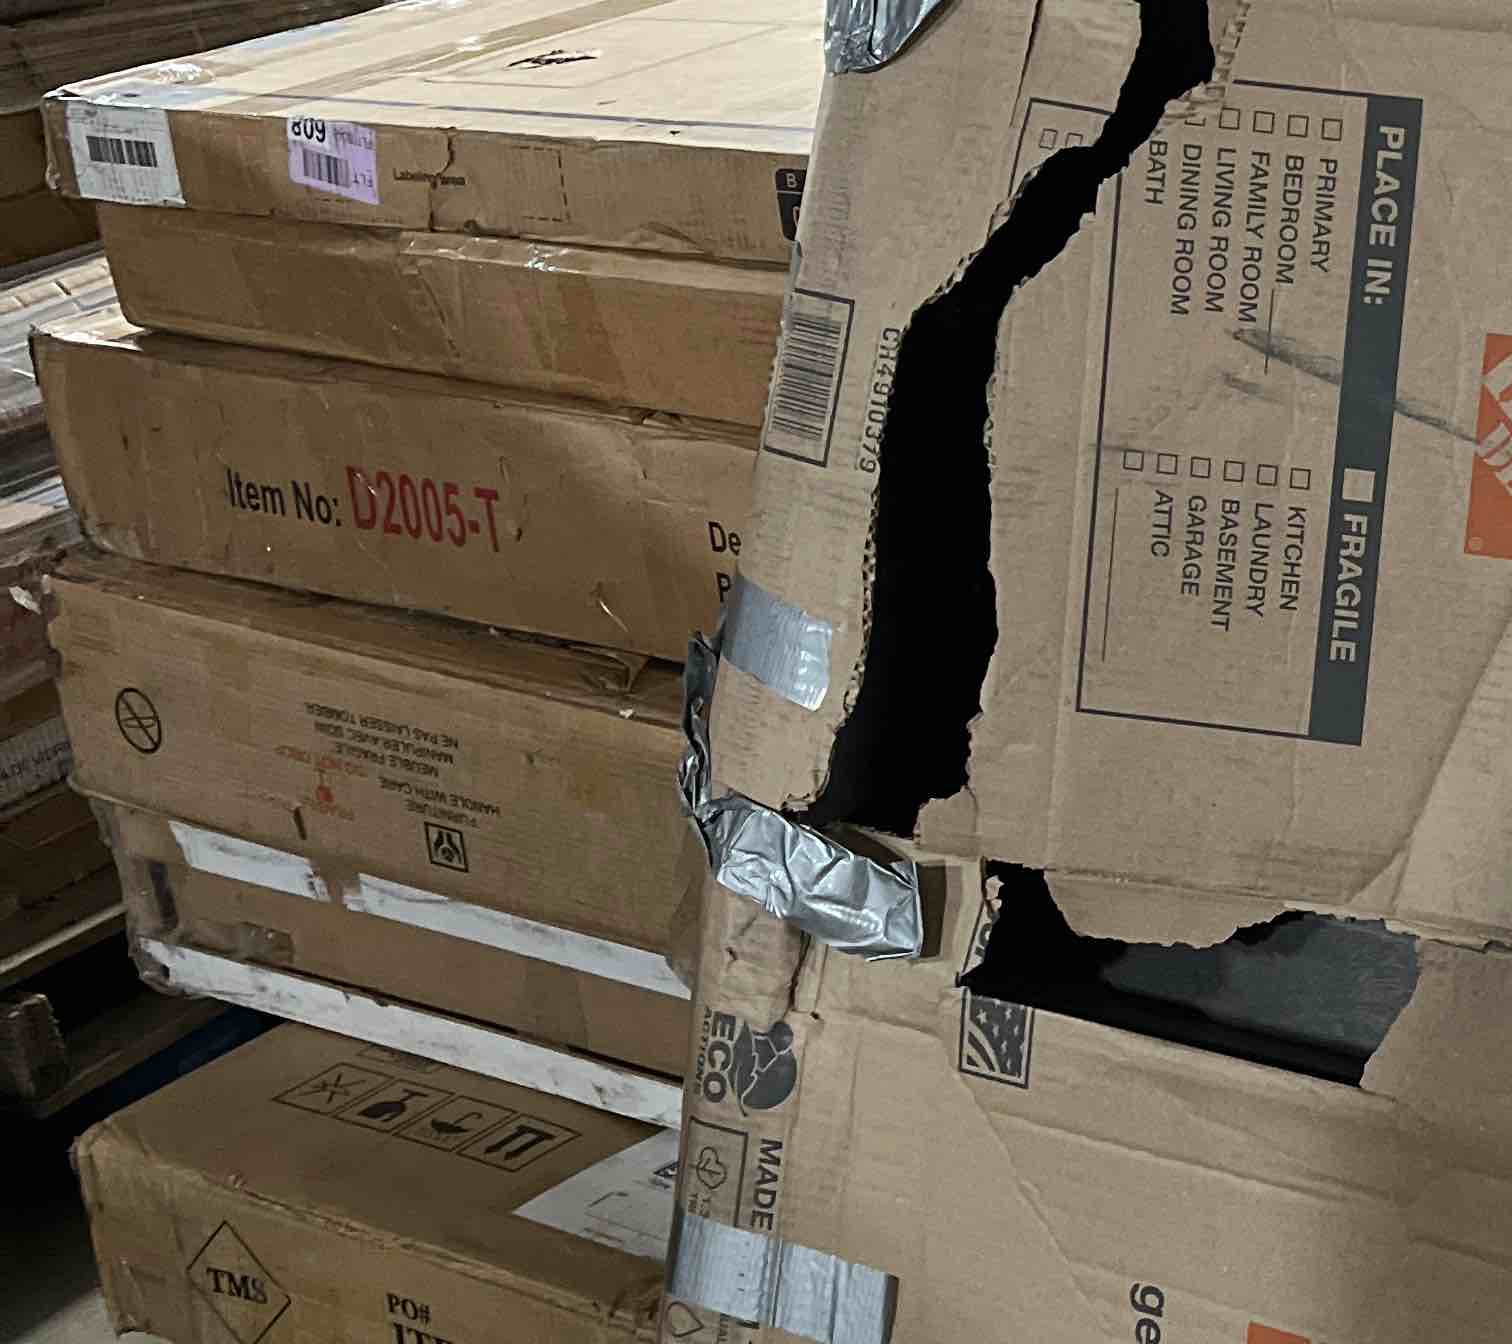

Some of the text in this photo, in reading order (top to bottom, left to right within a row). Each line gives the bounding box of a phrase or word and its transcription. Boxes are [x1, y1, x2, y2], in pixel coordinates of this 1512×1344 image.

[1144, 139, 1168, 206] BATH
[1275, 155, 1305, 285] BEDROOM
[1310, 157, 1338, 273] PRIMARY
[1363, 125, 1406, 305] PLACE IN:
[1170, 143, 1203, 316] DINING ROOM
[1204, 147, 1237, 313] LIVING ROOM
[1238, 149, 1271, 323] FAMILY ROOM
[226, 464, 500, 554] Item No: D2005-T
[1151, 489, 1174, 558] ATTIC
[1180, 495, 1208, 597] GARAGE
[1246, 502, 1275, 618] LAUNDRY
[1279, 507, 1307, 611] KITCHEN
[1210, 497, 1241, 632] BASEMENT
[1328, 513, 1369, 663] FRAGILE
[702, 1011, 737, 1104] ECO
[750, 1138, 784, 1232] MADE
[205, 1266, 269, 1306] TMS
[386, 1292, 431, 1326] PO#
